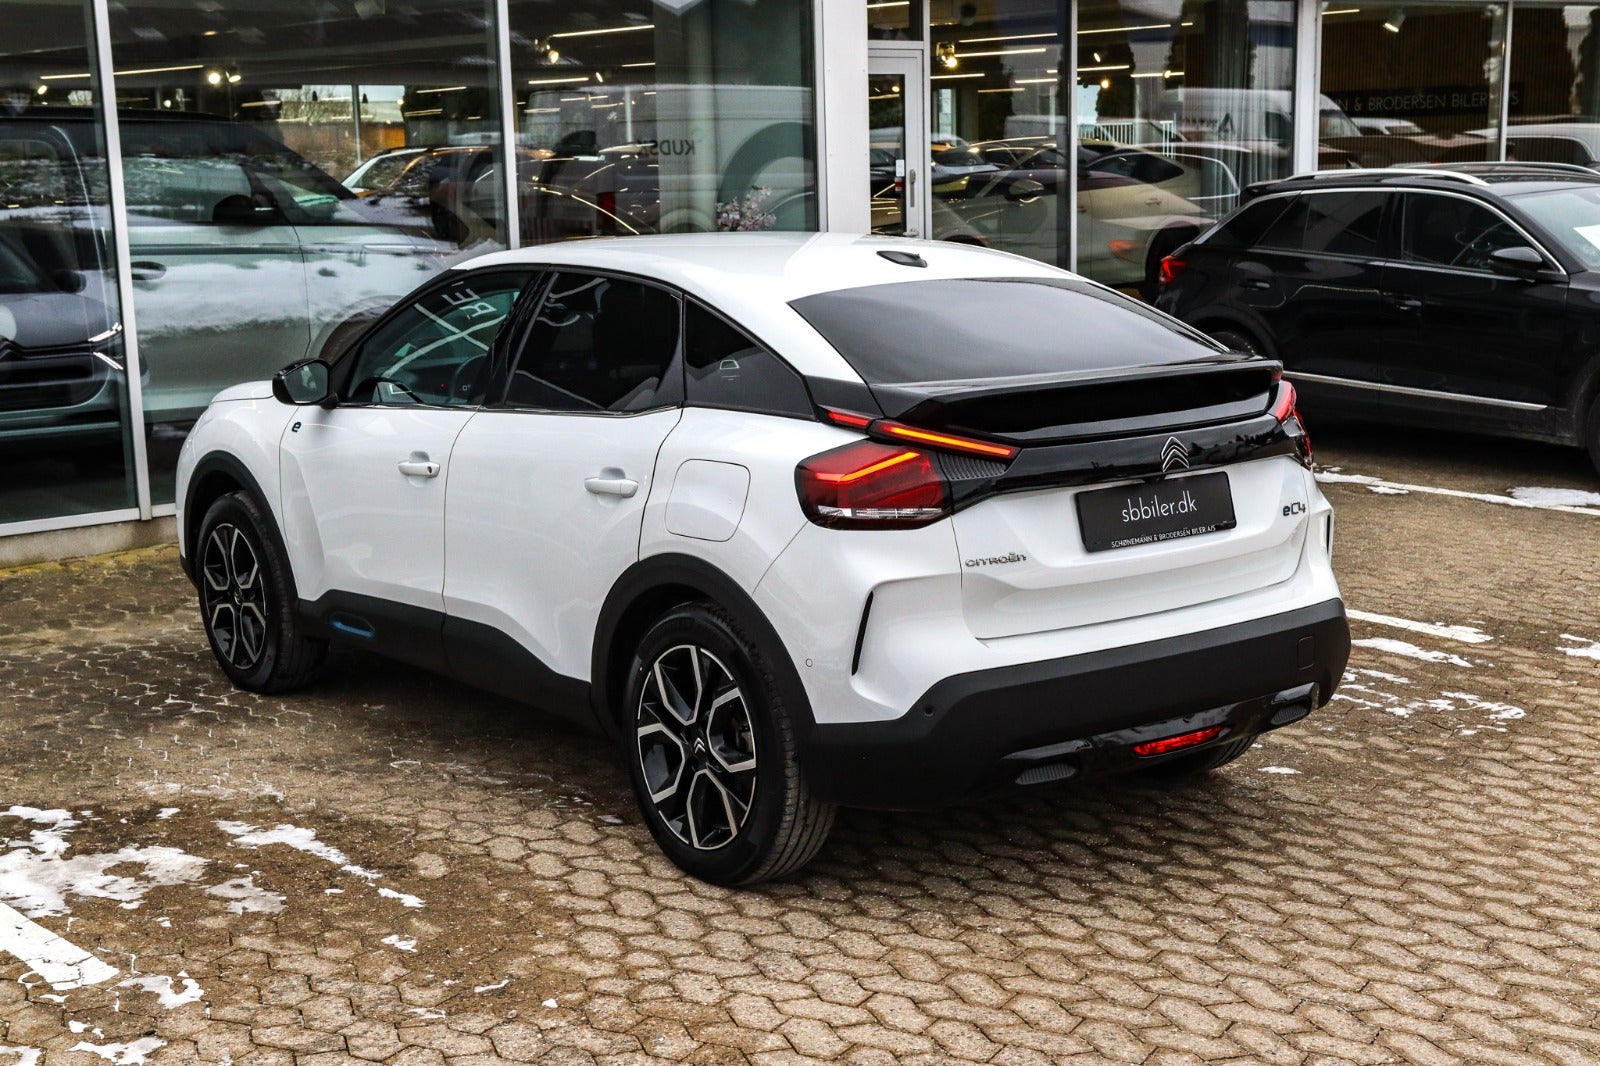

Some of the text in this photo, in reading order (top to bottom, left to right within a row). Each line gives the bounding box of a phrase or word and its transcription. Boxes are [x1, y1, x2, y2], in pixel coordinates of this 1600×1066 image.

[1353, 97, 1363, 112] &
[1368, 94, 1447, 111] BRODERSEN
[1451, 92, 1488, 108] BILER
[1121, 489, 1198, 523] sbbiler.dk
[1111, 534, 1153, 548] SCHØNEMANN
[1153, 533, 1159, 542] &
[1158, 527, 1191, 541] BRODERSEN
[1191, 525, 1206, 535] BILER
